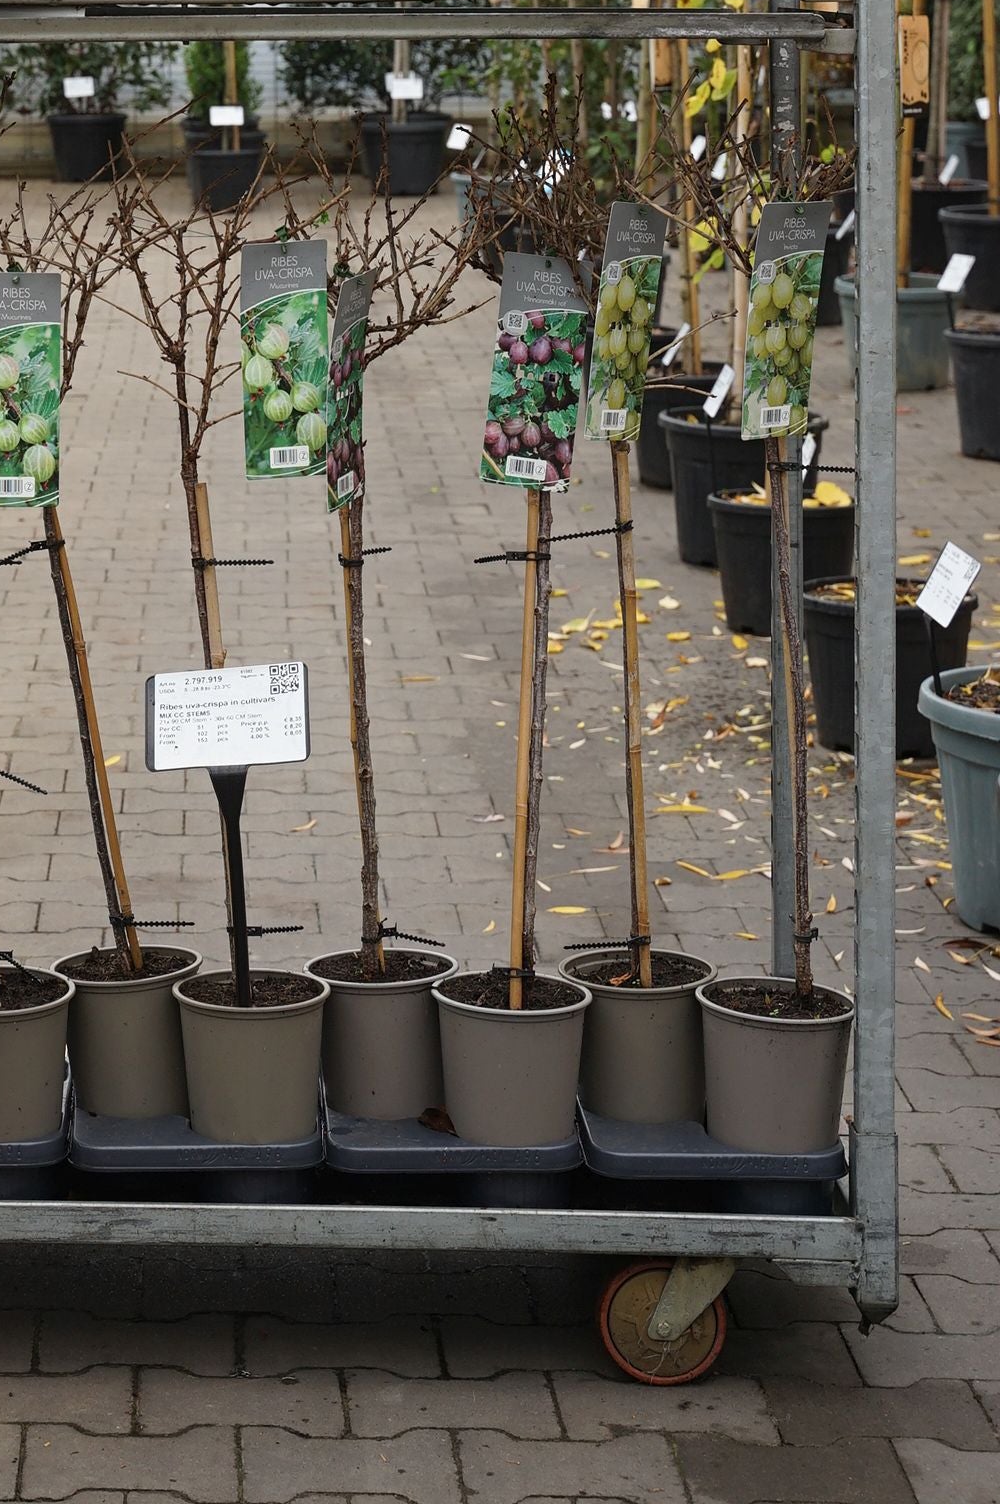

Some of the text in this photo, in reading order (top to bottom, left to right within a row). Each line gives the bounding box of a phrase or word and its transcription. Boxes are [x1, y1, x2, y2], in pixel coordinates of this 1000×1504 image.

[629, 219, 648, 231] RIBES
[783, 217, 806, 228] RIBES
[616, 231, 656, 244] UVA-CRISPA
[769, 229, 816, 242] UVA-CRISPA
[271, 256, 298, 267] RIBES
[255, 266, 314, 281] UVA-CRISPA
[533, 271, 561, 284] RIBES
[2, 287, 31, 298] RIBES
[185, 675, 223, 685] 2.797.919
[160, 703, 183, 711] Ribes
[186, 701, 228, 709] uva-crispa
[241, 696, 276, 705] cultivars
